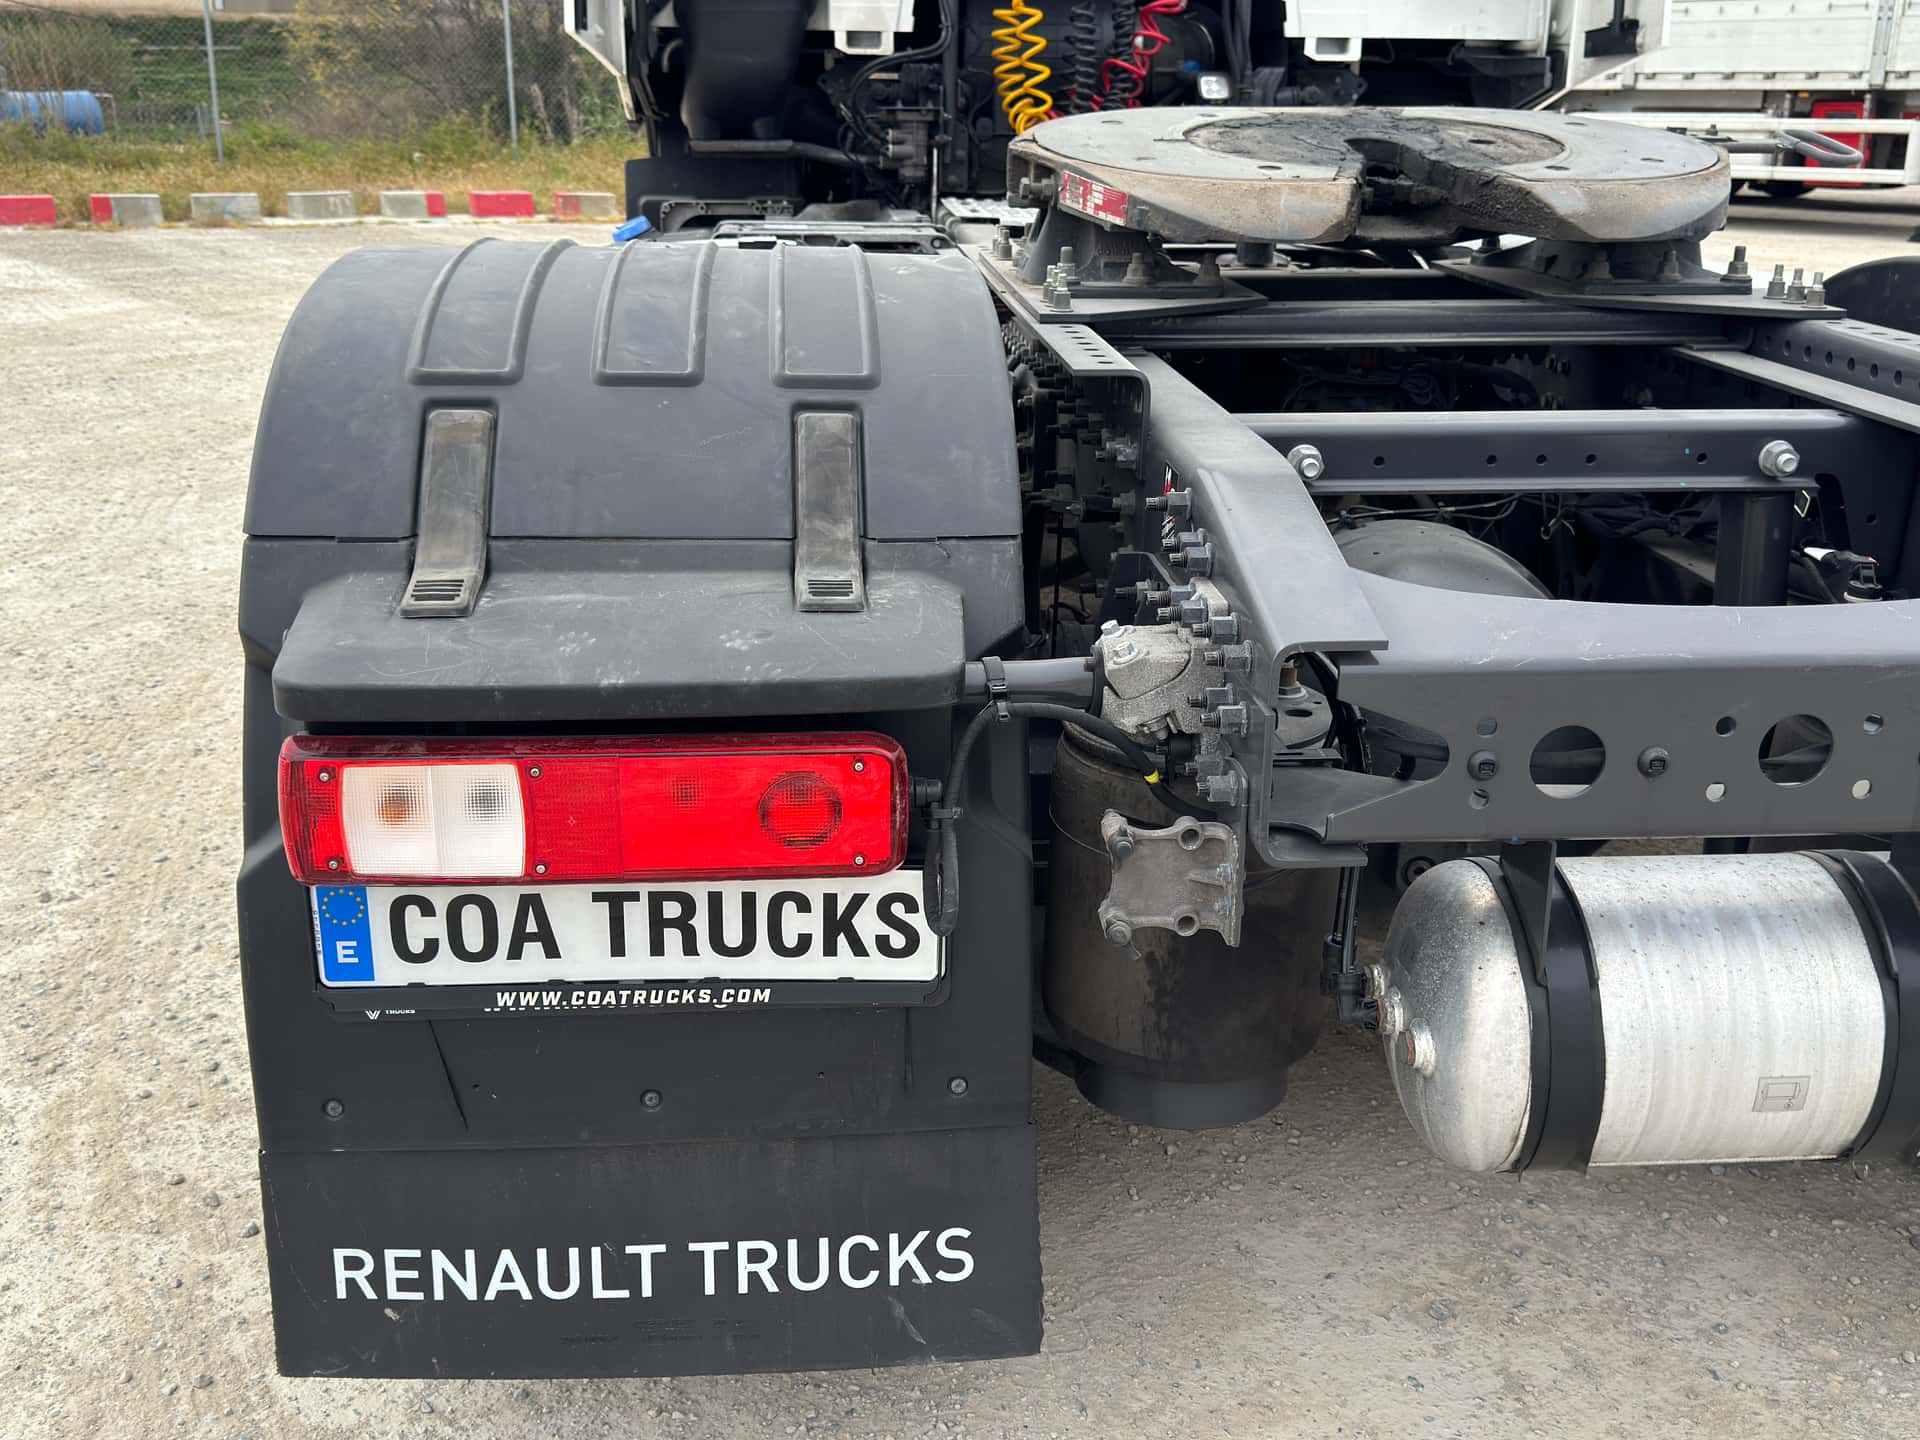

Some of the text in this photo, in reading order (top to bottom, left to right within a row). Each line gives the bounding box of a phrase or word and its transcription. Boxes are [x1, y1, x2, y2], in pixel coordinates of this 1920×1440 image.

[389, 893, 562, 964] COA
[591, 890, 921, 959] TRUCKS
[335, 940, 360, 964] E
[495, 987, 771, 1007] WWW.COATRUCKS.COM
[332, 1227, 976, 1301] RENAULT TRUCKS
